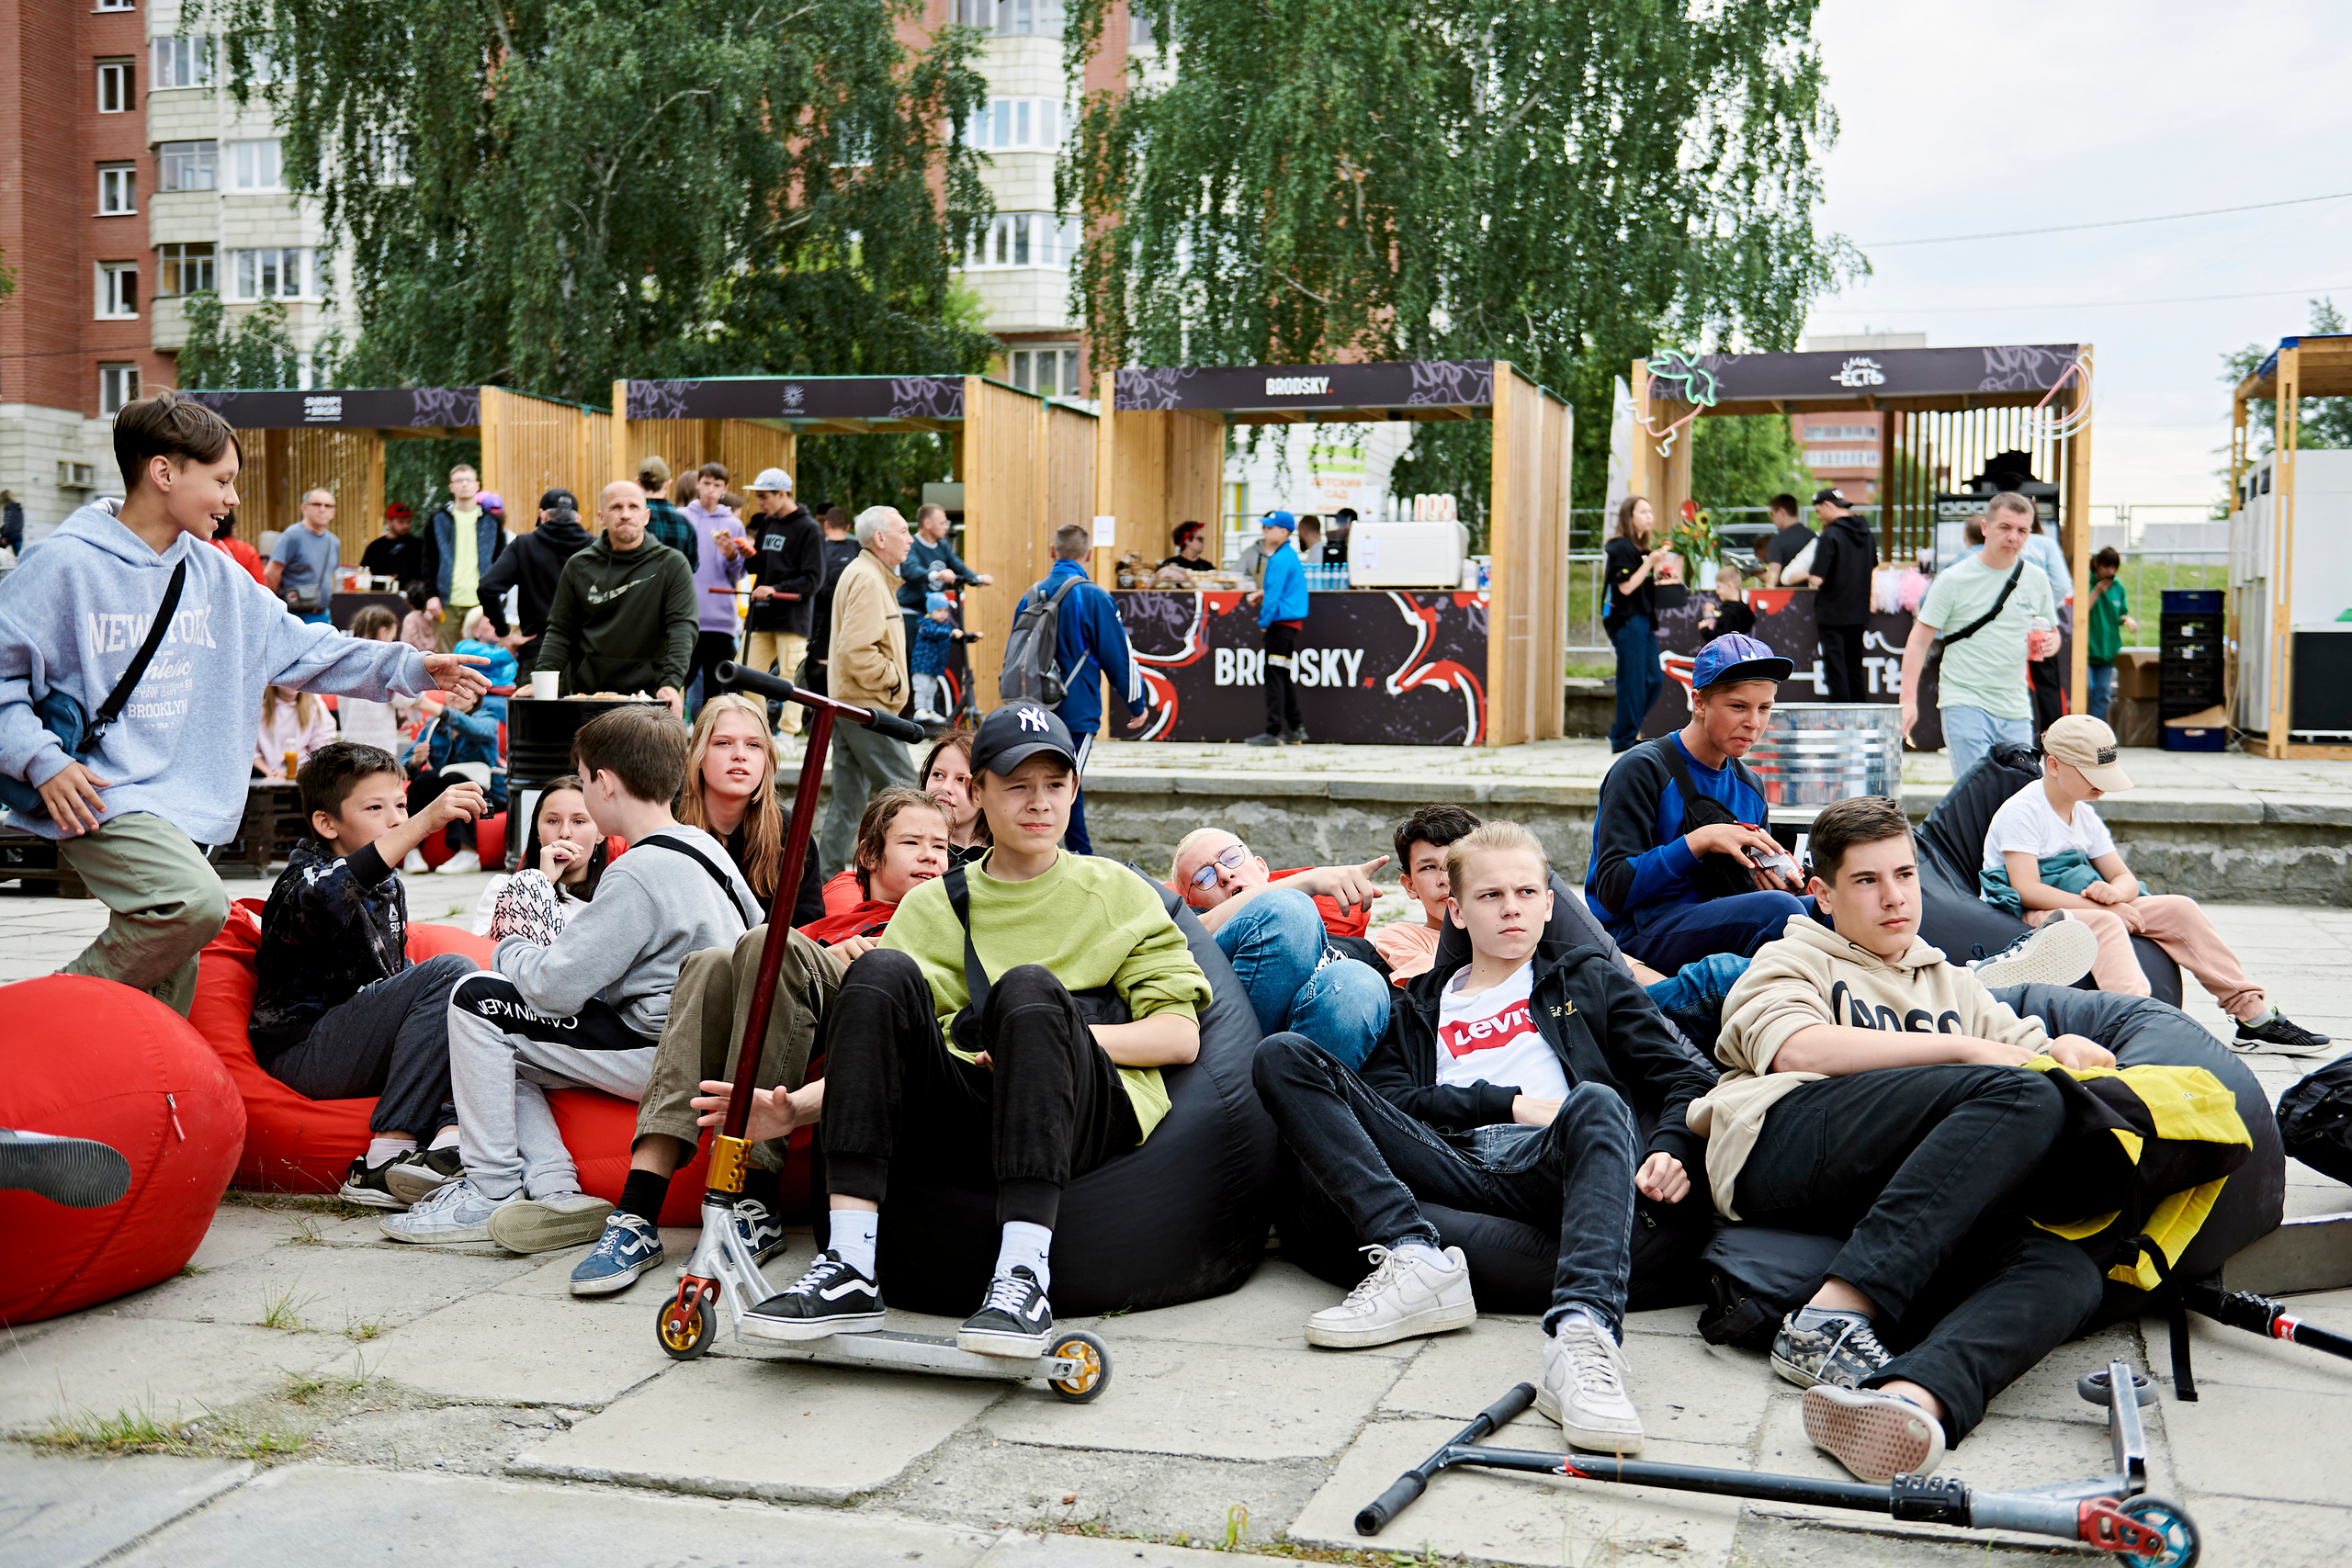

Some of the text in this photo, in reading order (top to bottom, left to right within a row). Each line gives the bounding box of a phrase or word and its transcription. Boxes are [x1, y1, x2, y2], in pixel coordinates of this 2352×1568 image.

[1266, 377, 1334, 395] BRODSKY.
[88, 612, 152, 659] NEW
[116, 656, 194, 681] hletic
[128, 699, 188, 718] BROOKLYN
